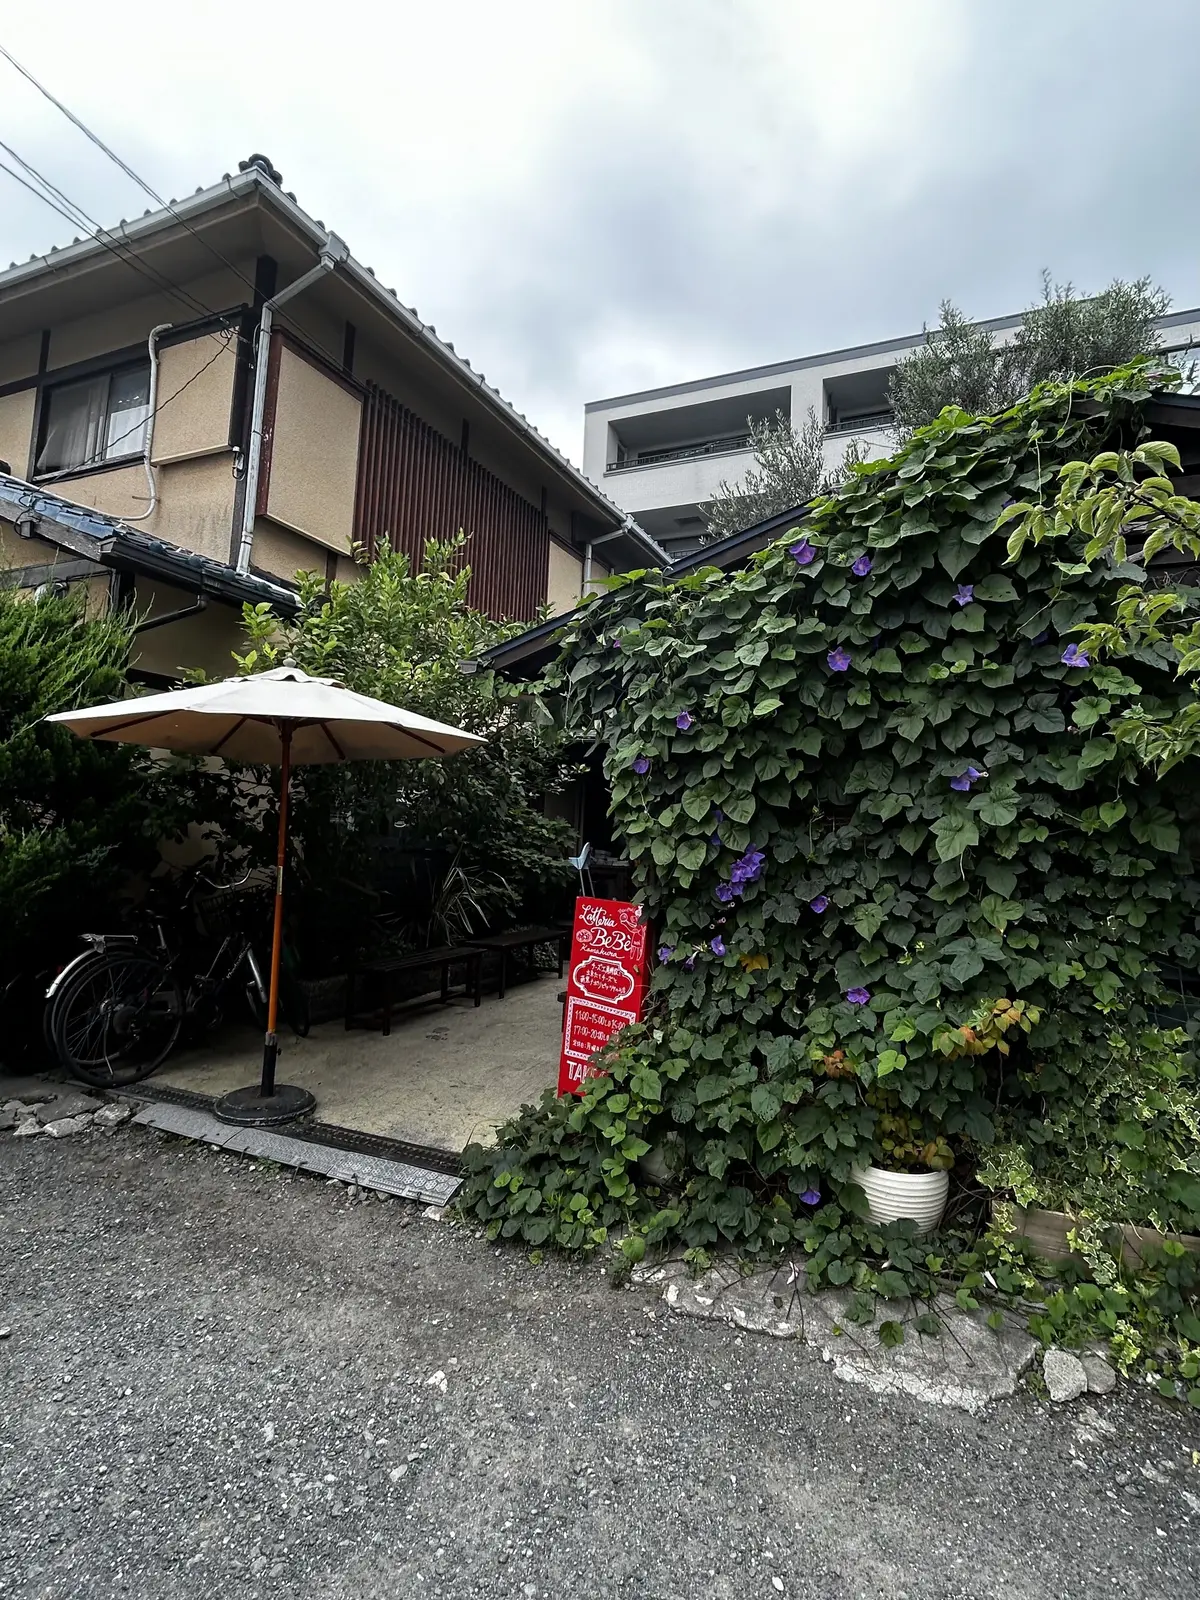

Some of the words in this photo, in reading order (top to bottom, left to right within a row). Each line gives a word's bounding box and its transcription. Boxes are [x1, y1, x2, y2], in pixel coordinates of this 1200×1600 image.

[579, 904, 617, 927] Latteria
[590, 927, 631, 951] BeBè
[580, 943, 625, 959] Kamakura
